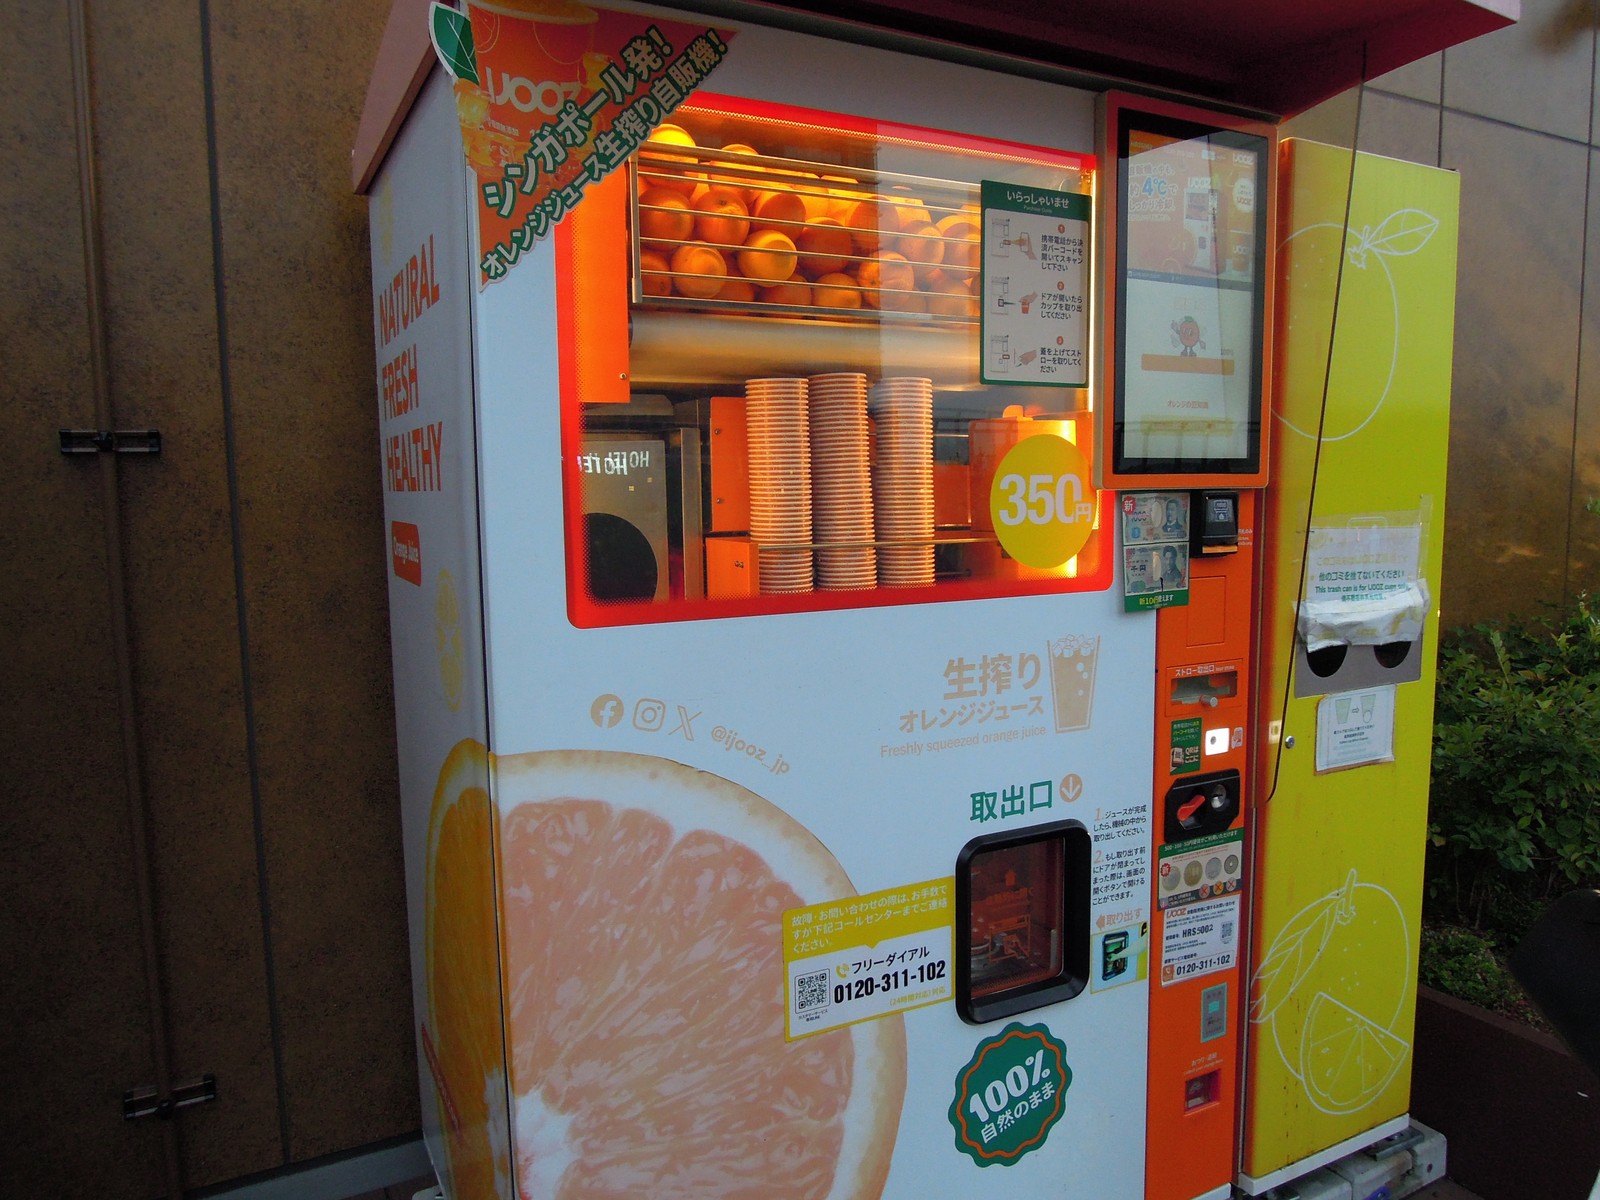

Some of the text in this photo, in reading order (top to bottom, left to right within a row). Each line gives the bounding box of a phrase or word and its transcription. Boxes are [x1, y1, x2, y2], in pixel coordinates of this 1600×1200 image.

[1007, 190, 1069, 209] いらっしゃいませ
[379, 233, 441, 349] NATURAL
[382, 344, 420, 422] FRESH
[386, 421, 443, 493] HEALTHY
[999, 473, 1093, 527] 350円
[943, 652, 1042, 700] 生搾り
[899, 695, 1045, 734] オレンジジュース
[711, 725, 790, 776] @ijooz_jp
[879, 723, 1047, 759] Freshly squeezed orange juice
[970, 780, 1054, 824] 取出口
[1105, 804, 1147, 820] ジュースが完成
[1105, 846, 1146, 862] もし取り出す前
[834, 959, 946, 1004] 0120-311-102
[852, 946, 930, 974] フリーダイアル
[1176, 954, 1231, 976] 0120-311-102
[969, 1049, 1051, 1123] 100%
[981, 1081, 1055, 1144] 自然のまま
